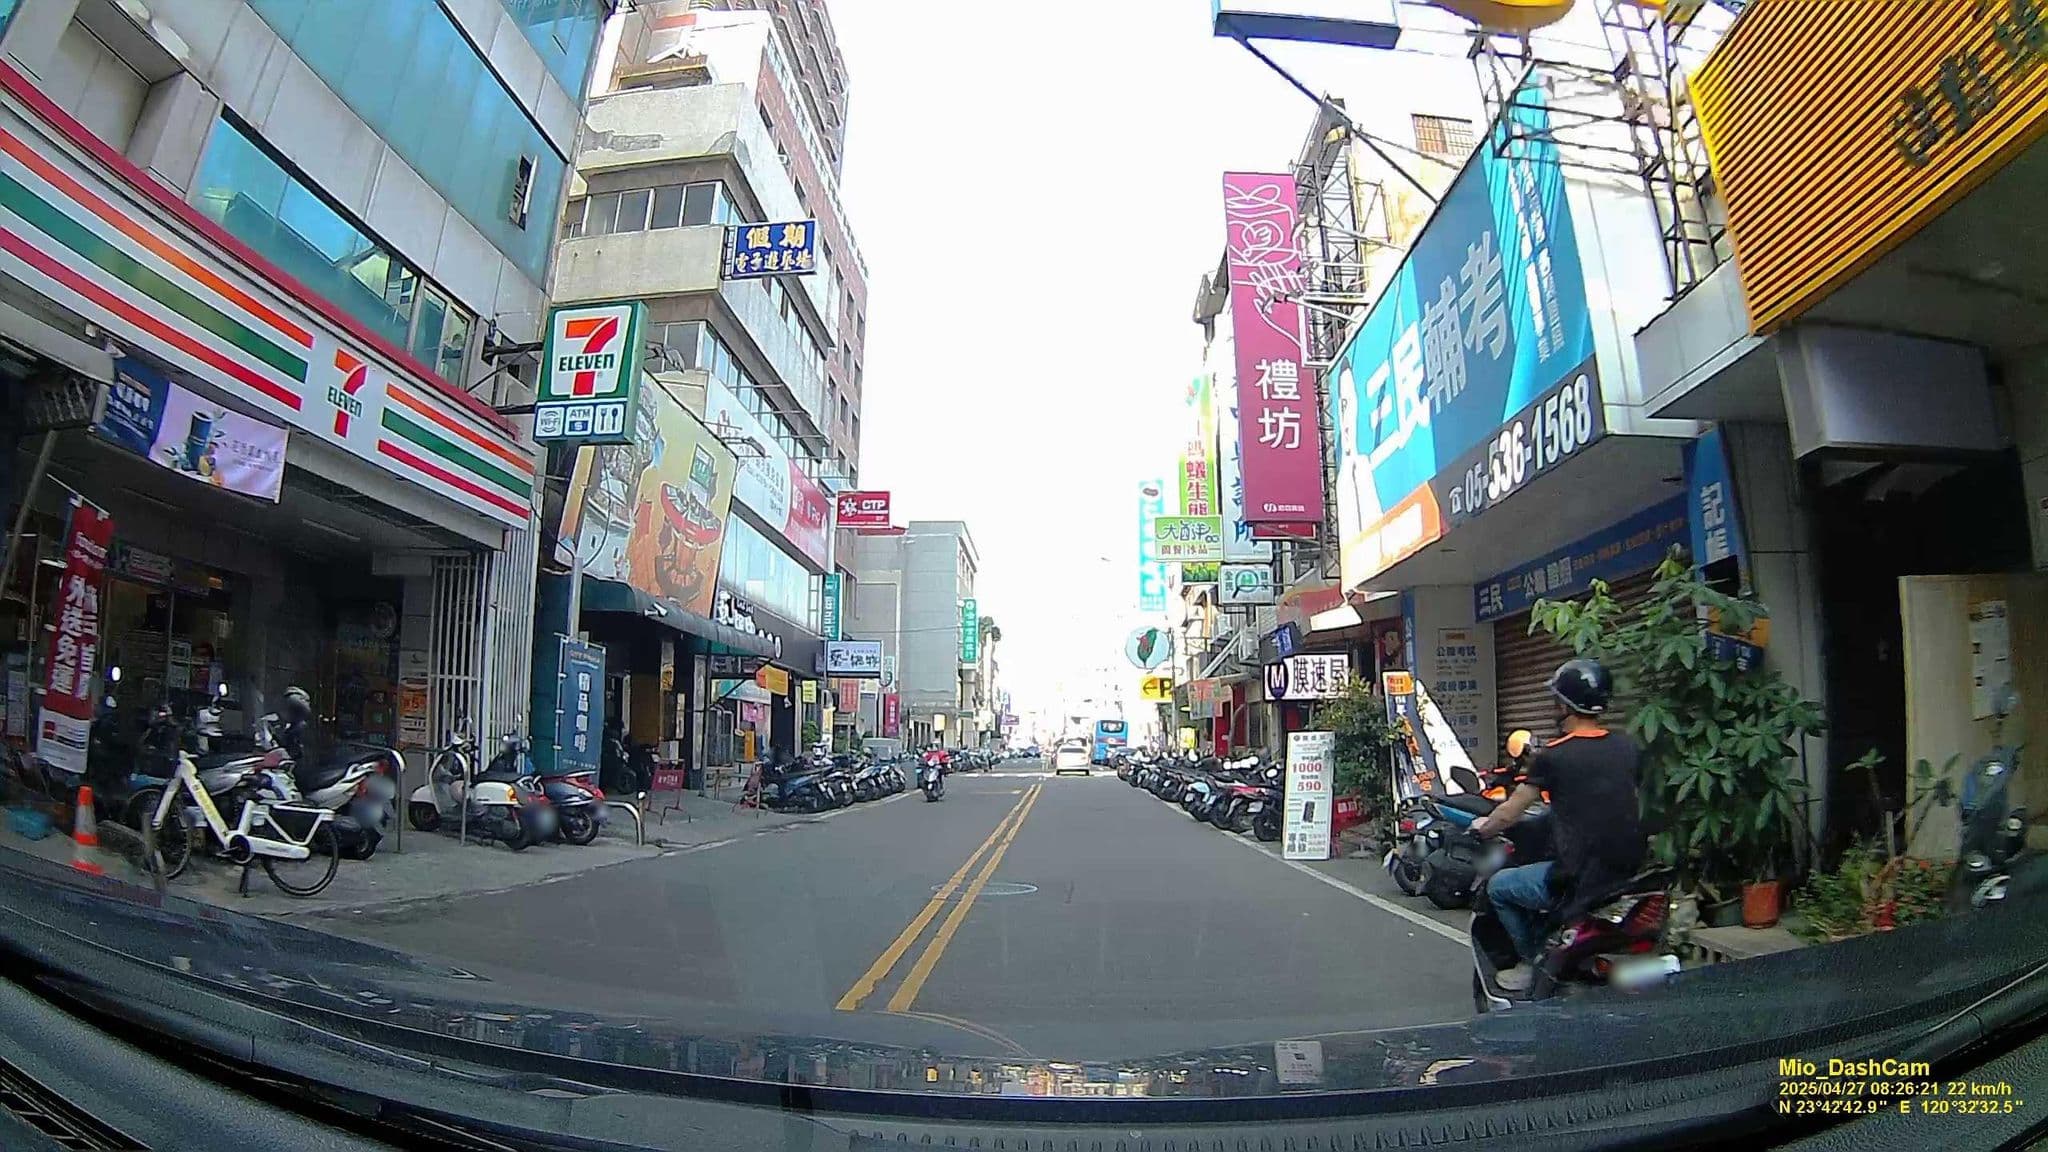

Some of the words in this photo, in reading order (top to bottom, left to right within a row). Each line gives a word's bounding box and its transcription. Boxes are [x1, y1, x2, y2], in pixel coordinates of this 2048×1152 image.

[745, 223, 806, 249] 假期
[565, 316, 618, 396] 7
[334, 349, 368, 438] 7
[1254, 358, 1301, 449] 禮坊
[569, 408, 590, 418] ATM
[1465, 374, 1592, 513] 05-536-1568
[861, 499, 886, 511] CTP
[1292, 762, 1322, 773] 1000
[1297, 780, 1322, 792] 590
